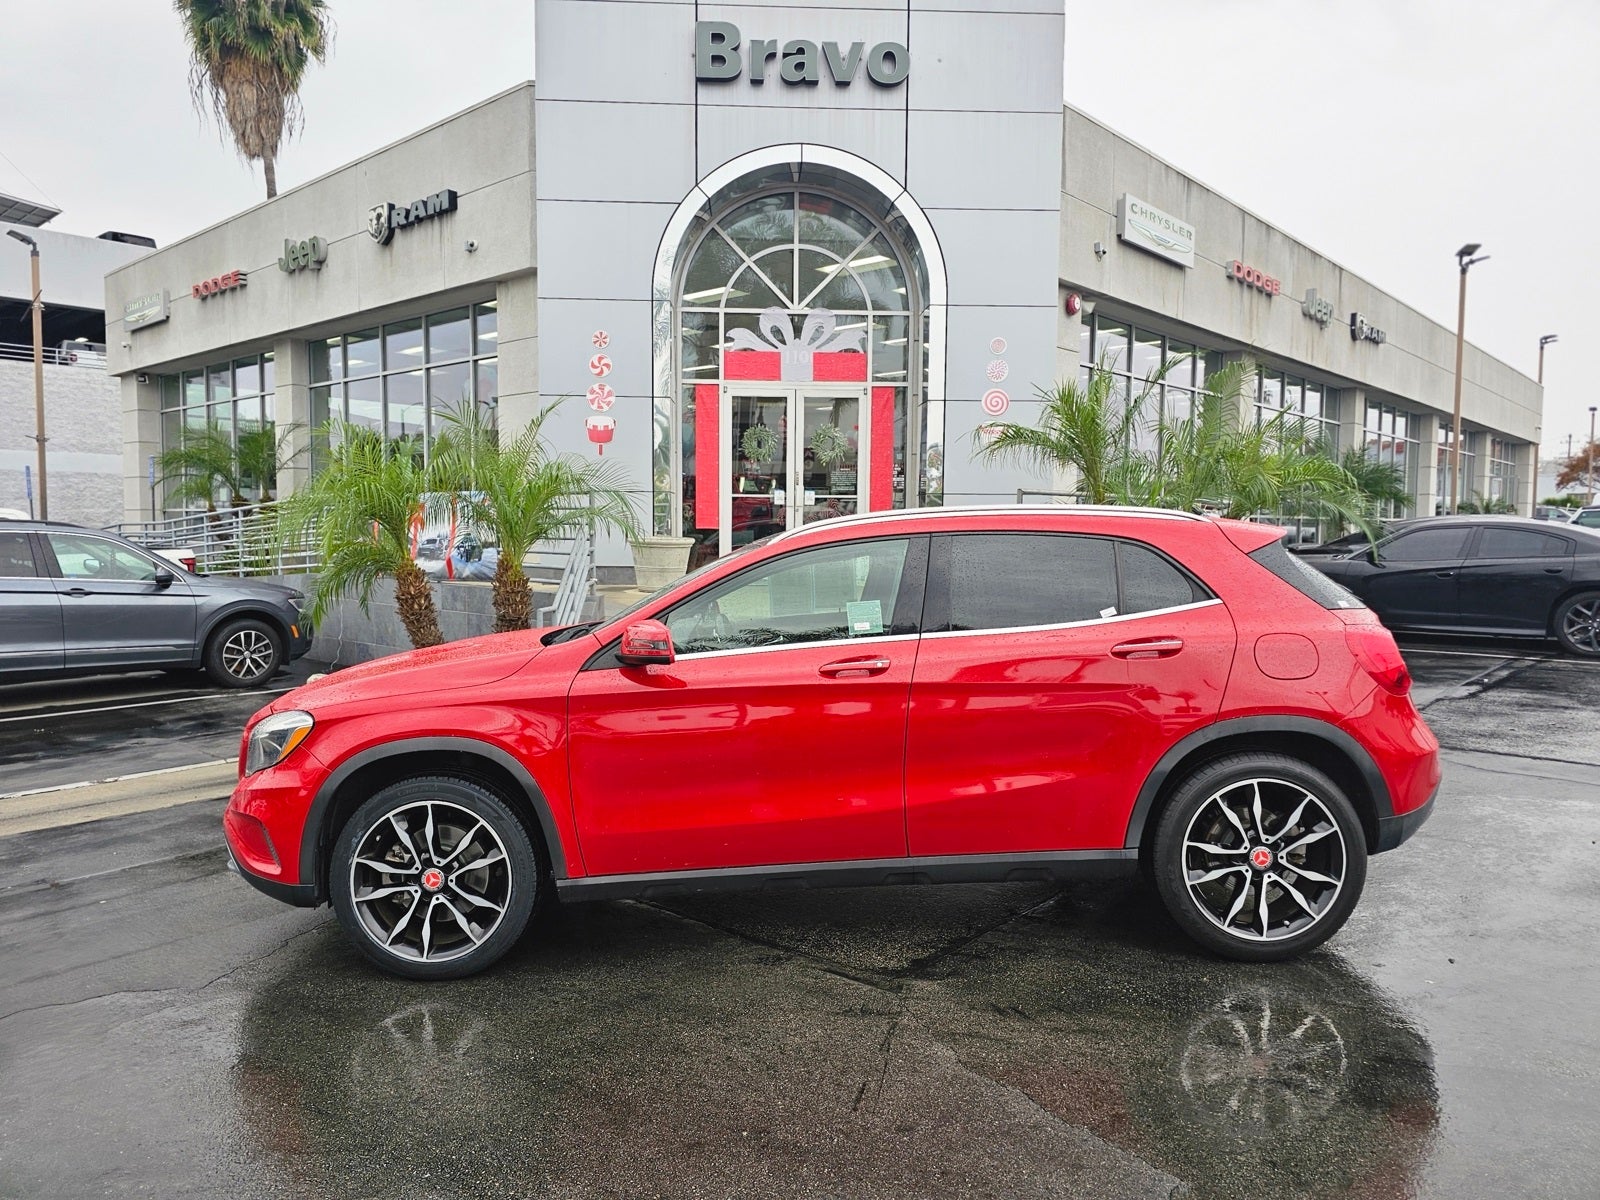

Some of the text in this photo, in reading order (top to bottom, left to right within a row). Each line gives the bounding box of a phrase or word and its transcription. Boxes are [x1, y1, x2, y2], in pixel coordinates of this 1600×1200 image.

[696, 21, 910, 87] Bravo
[390, 190, 454, 228] RAM
[1130, 202, 1193, 241] CHRYSLER
[278, 236, 322, 273] Jeep
[192, 270, 243, 300] DODGE
[1233, 259, 1281, 296] DODGE
[1308, 290, 1335, 329] Jeep
[1365, 324, 1387, 344] RAM
